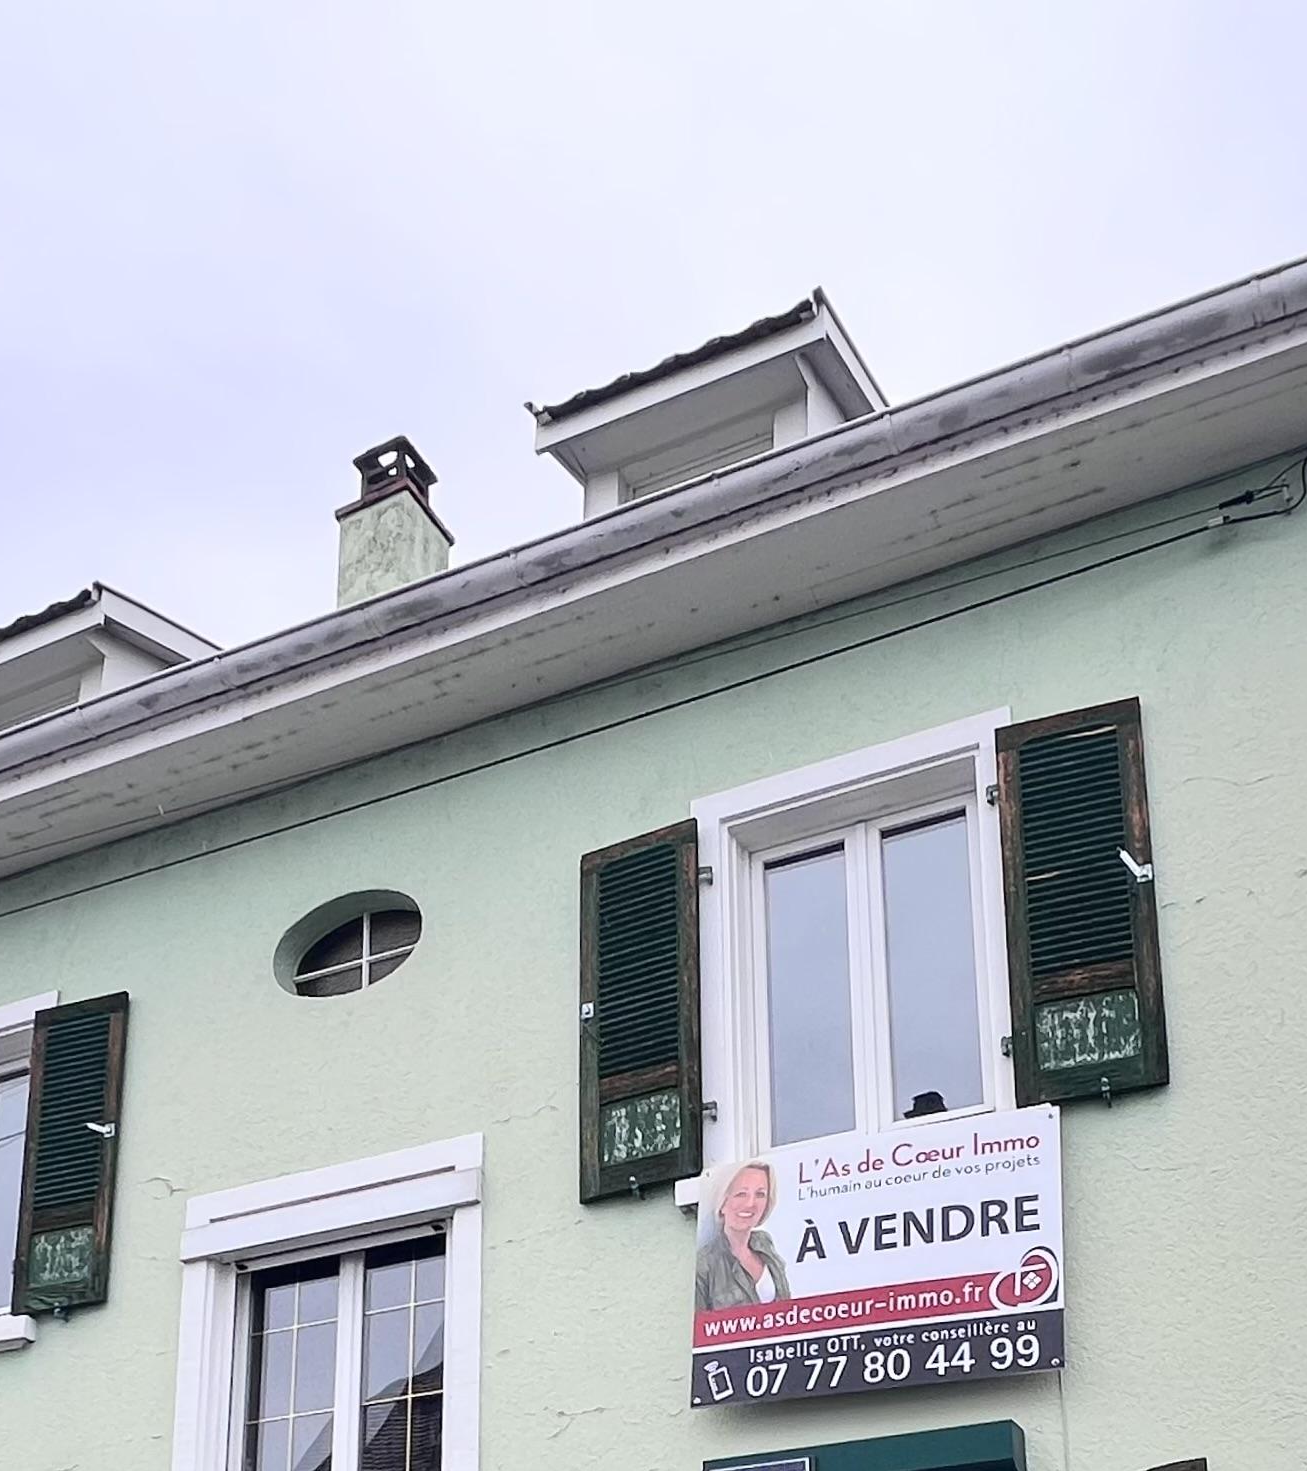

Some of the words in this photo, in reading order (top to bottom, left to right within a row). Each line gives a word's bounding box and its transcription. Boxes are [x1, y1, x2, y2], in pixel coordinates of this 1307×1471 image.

[798, 1180, 861, 1200] L'humain
[865, 1180, 882, 1190] au
[885, 1171, 928, 1186] coeur
[932, 1165, 951, 1179] de
[955, 1164, 981, 1175] vos
[985, 1154, 1040, 1175] projets
[799, 1157, 851, 1184] L'As
[857, 1148, 884, 1173] de
[892, 1143, 964, 1166] Cœur
[974, 1133, 1040, 1155] Immo
[795, 1219, 827, 1263] À
[839, 1194, 1041, 1256] VENDRE
[704, 1282, 984, 1337] www.asdecoeur-immo.fr
[746, 1363, 788, 1397] 07
[804, 1356, 848, 1390] 77
[863, 1348, 911, 1383] 80
[925, 1341, 975, 1376] 44
[990, 1334, 1040, 1370] 99
[750, 1341, 819, 1363] Isabelle
[874, 1333, 915, 1347] votre
[921, 1320, 1009, 1341] conseillère
[1016, 1320, 1036, 1332] au
